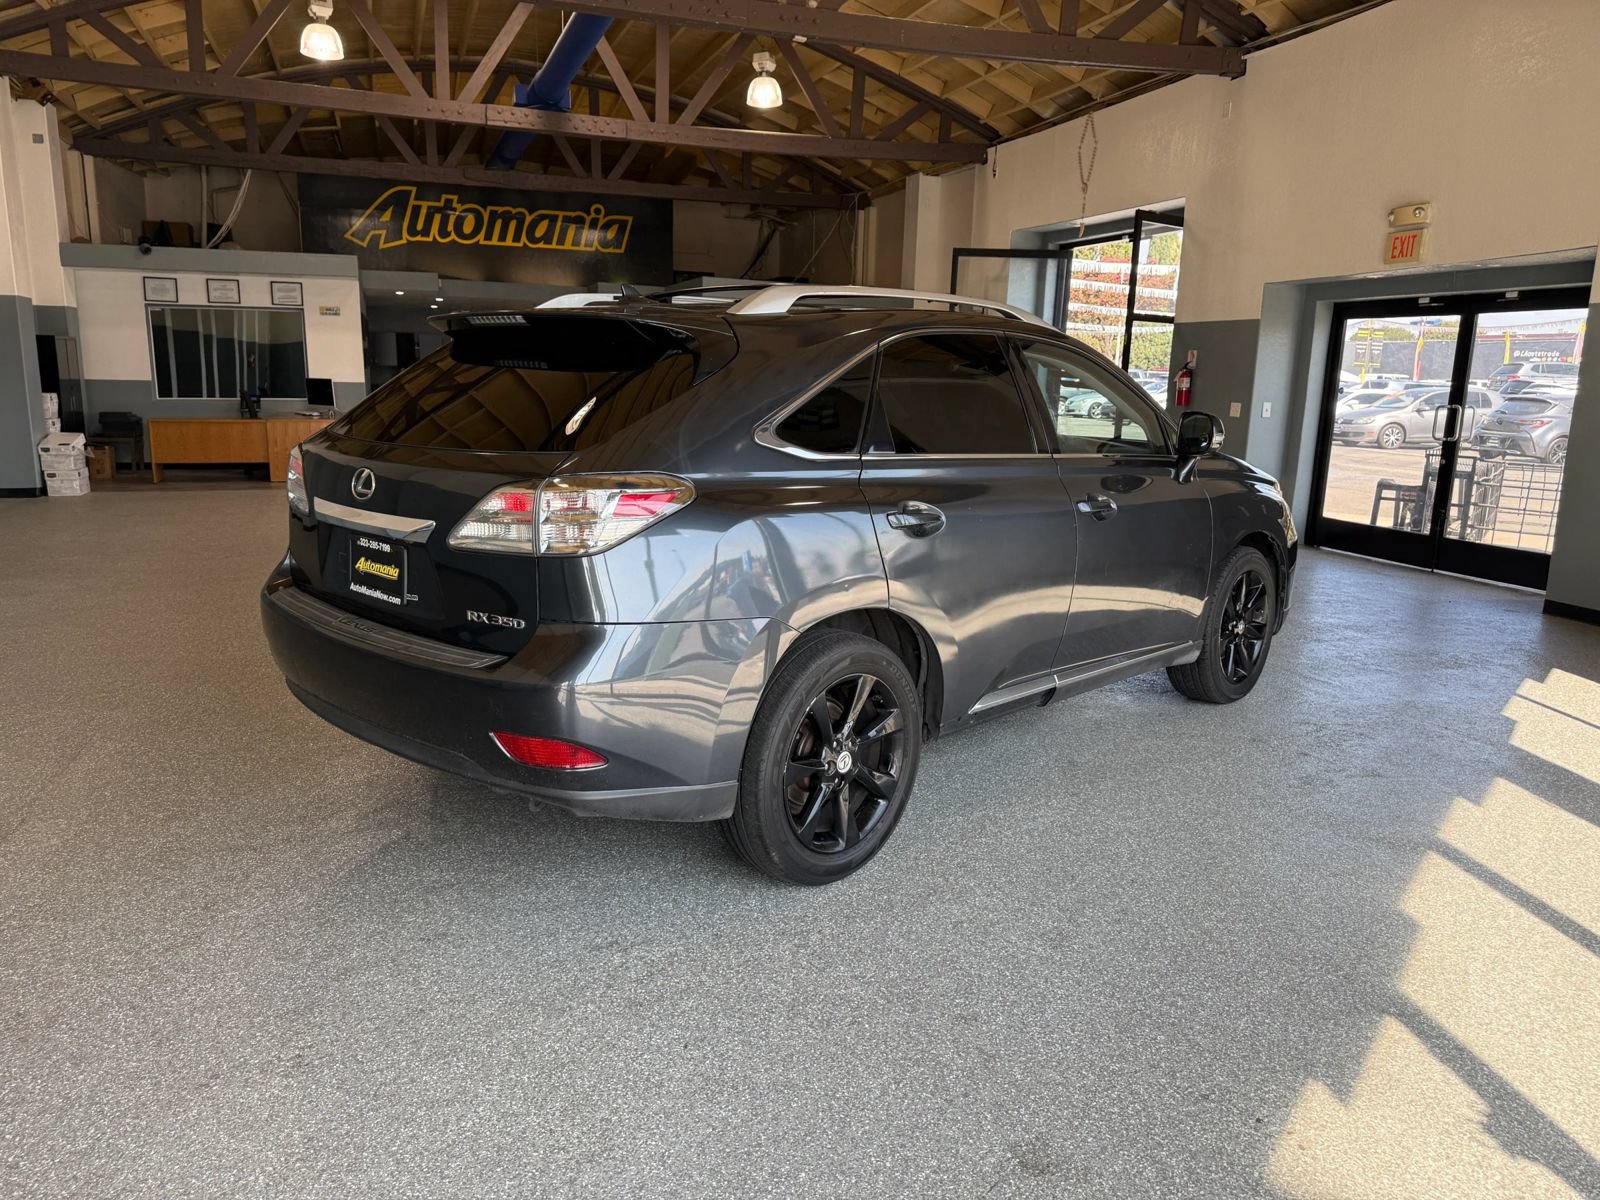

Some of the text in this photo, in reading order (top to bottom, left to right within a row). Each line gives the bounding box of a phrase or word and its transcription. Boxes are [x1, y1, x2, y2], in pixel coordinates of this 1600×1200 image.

[344, 185, 633, 253] Automania
[1391, 233, 1417, 259] EXIT
[355, 556, 399, 577] Automania
[350, 582, 401, 605] AutoManiaNow.com
[466, 610, 525, 629] RX 350
[889, 664, 917, 712] DUNLOP
